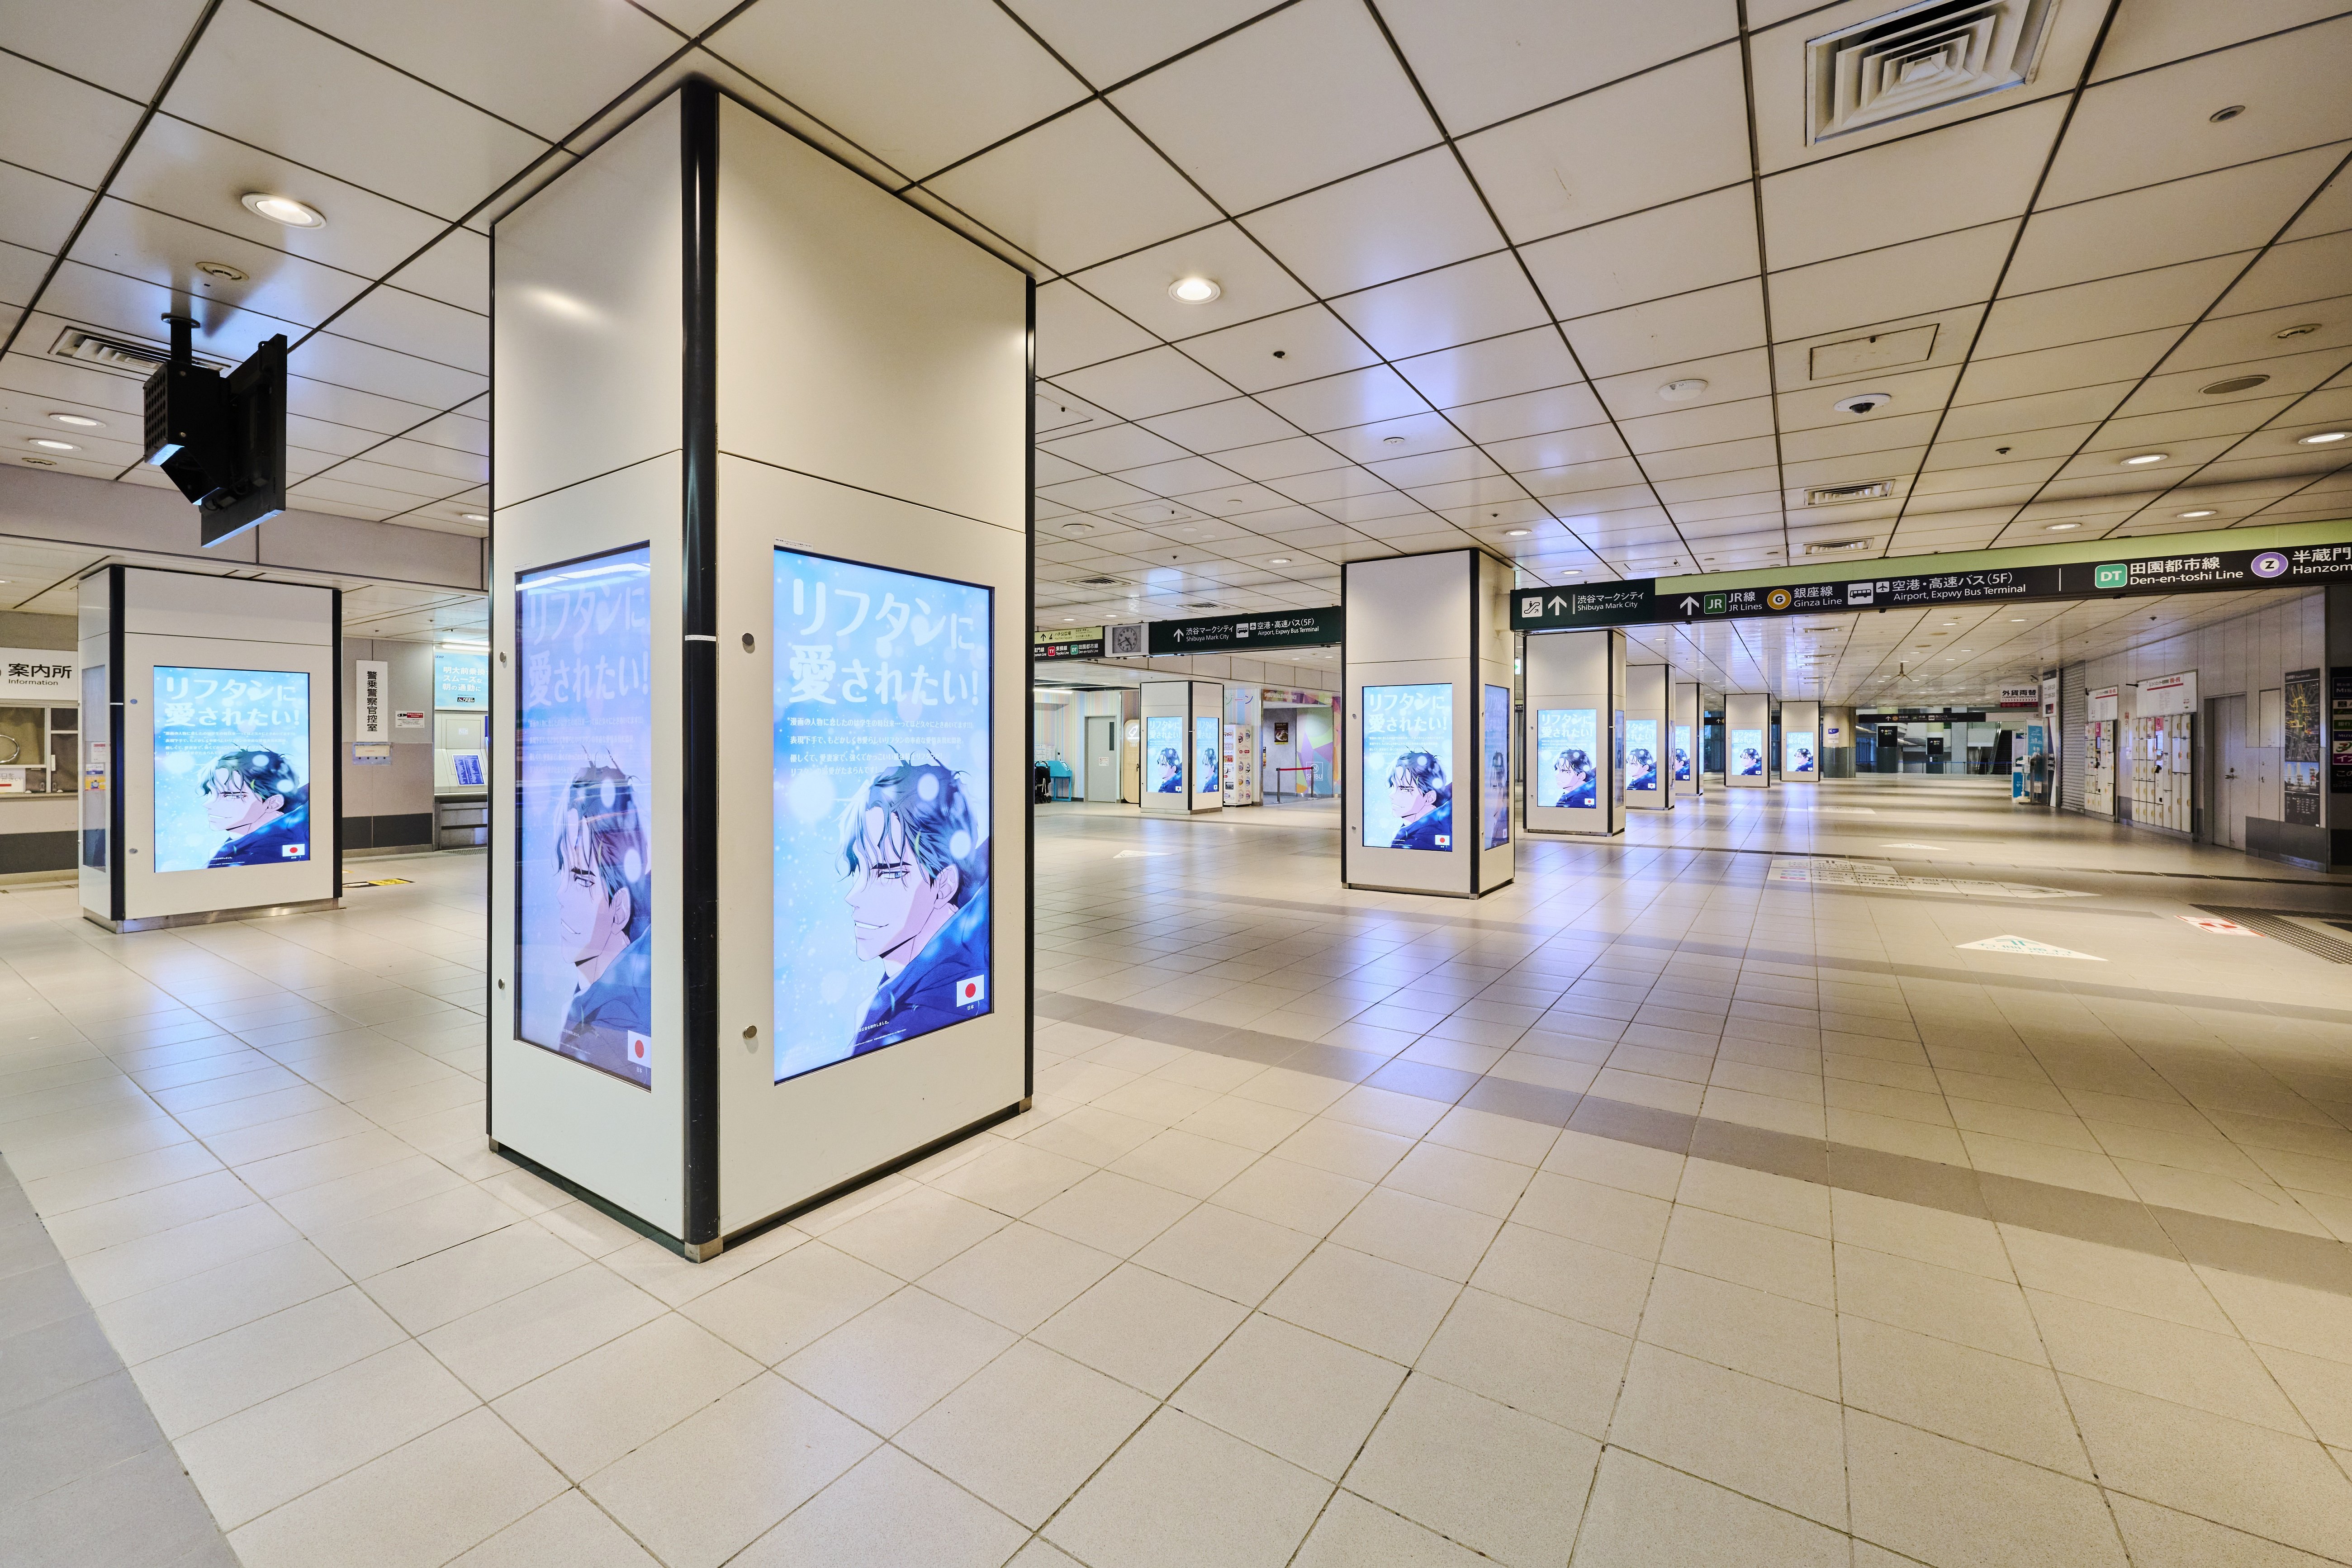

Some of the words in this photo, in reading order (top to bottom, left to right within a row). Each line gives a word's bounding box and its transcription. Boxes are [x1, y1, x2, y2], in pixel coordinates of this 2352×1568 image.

[2292, 547, 2351, 563] 半蔵門
[2130, 556, 2220, 575] 田園都市線
[2265, 560, 2274, 569] Z
[2101, 571, 2122, 582] DT
[2130, 571, 2212, 585] Den-en-toshi
[2216, 570, 2243, 579] Line
[1578, 592, 1645, 604] 渋谷マークシティ
[1729, 592, 1755, 603] JR線
[1794, 586, 1833, 598] 銀座線
[1893, 592, 1929, 602] Airport,
[1932, 589, 1962, 598] Expwy
[1983, 584, 2025, 594] Terminal
[1708, 599, 1722, 609] JR
[530, 581, 645, 646] リフタンに
[792, 578, 975, 650] リフタンに
[1186, 625, 1233, 635] 渋谷マークシティ
[8, 663, 72, 678] 案内所
[788, 644, 979, 706] 愛されたい!
[443, 675, 483, 683] スムーズな
[528, 650, 649, 707] 愛されたい!
[166, 677, 297, 701] リフタンに
[367, 671, 378, 732] 警乗警察官控室
[1370, 692, 1445, 711] リフタンに
[164, 702, 299, 727] 愛されたい!
[1542, 714, 1591, 725] リフタンに
[1150, 721, 1180, 729] リフタンに
[1369, 714, 1447, 733] 愛されたい!
[1541, 726, 1593, 738] 愛されたい!
